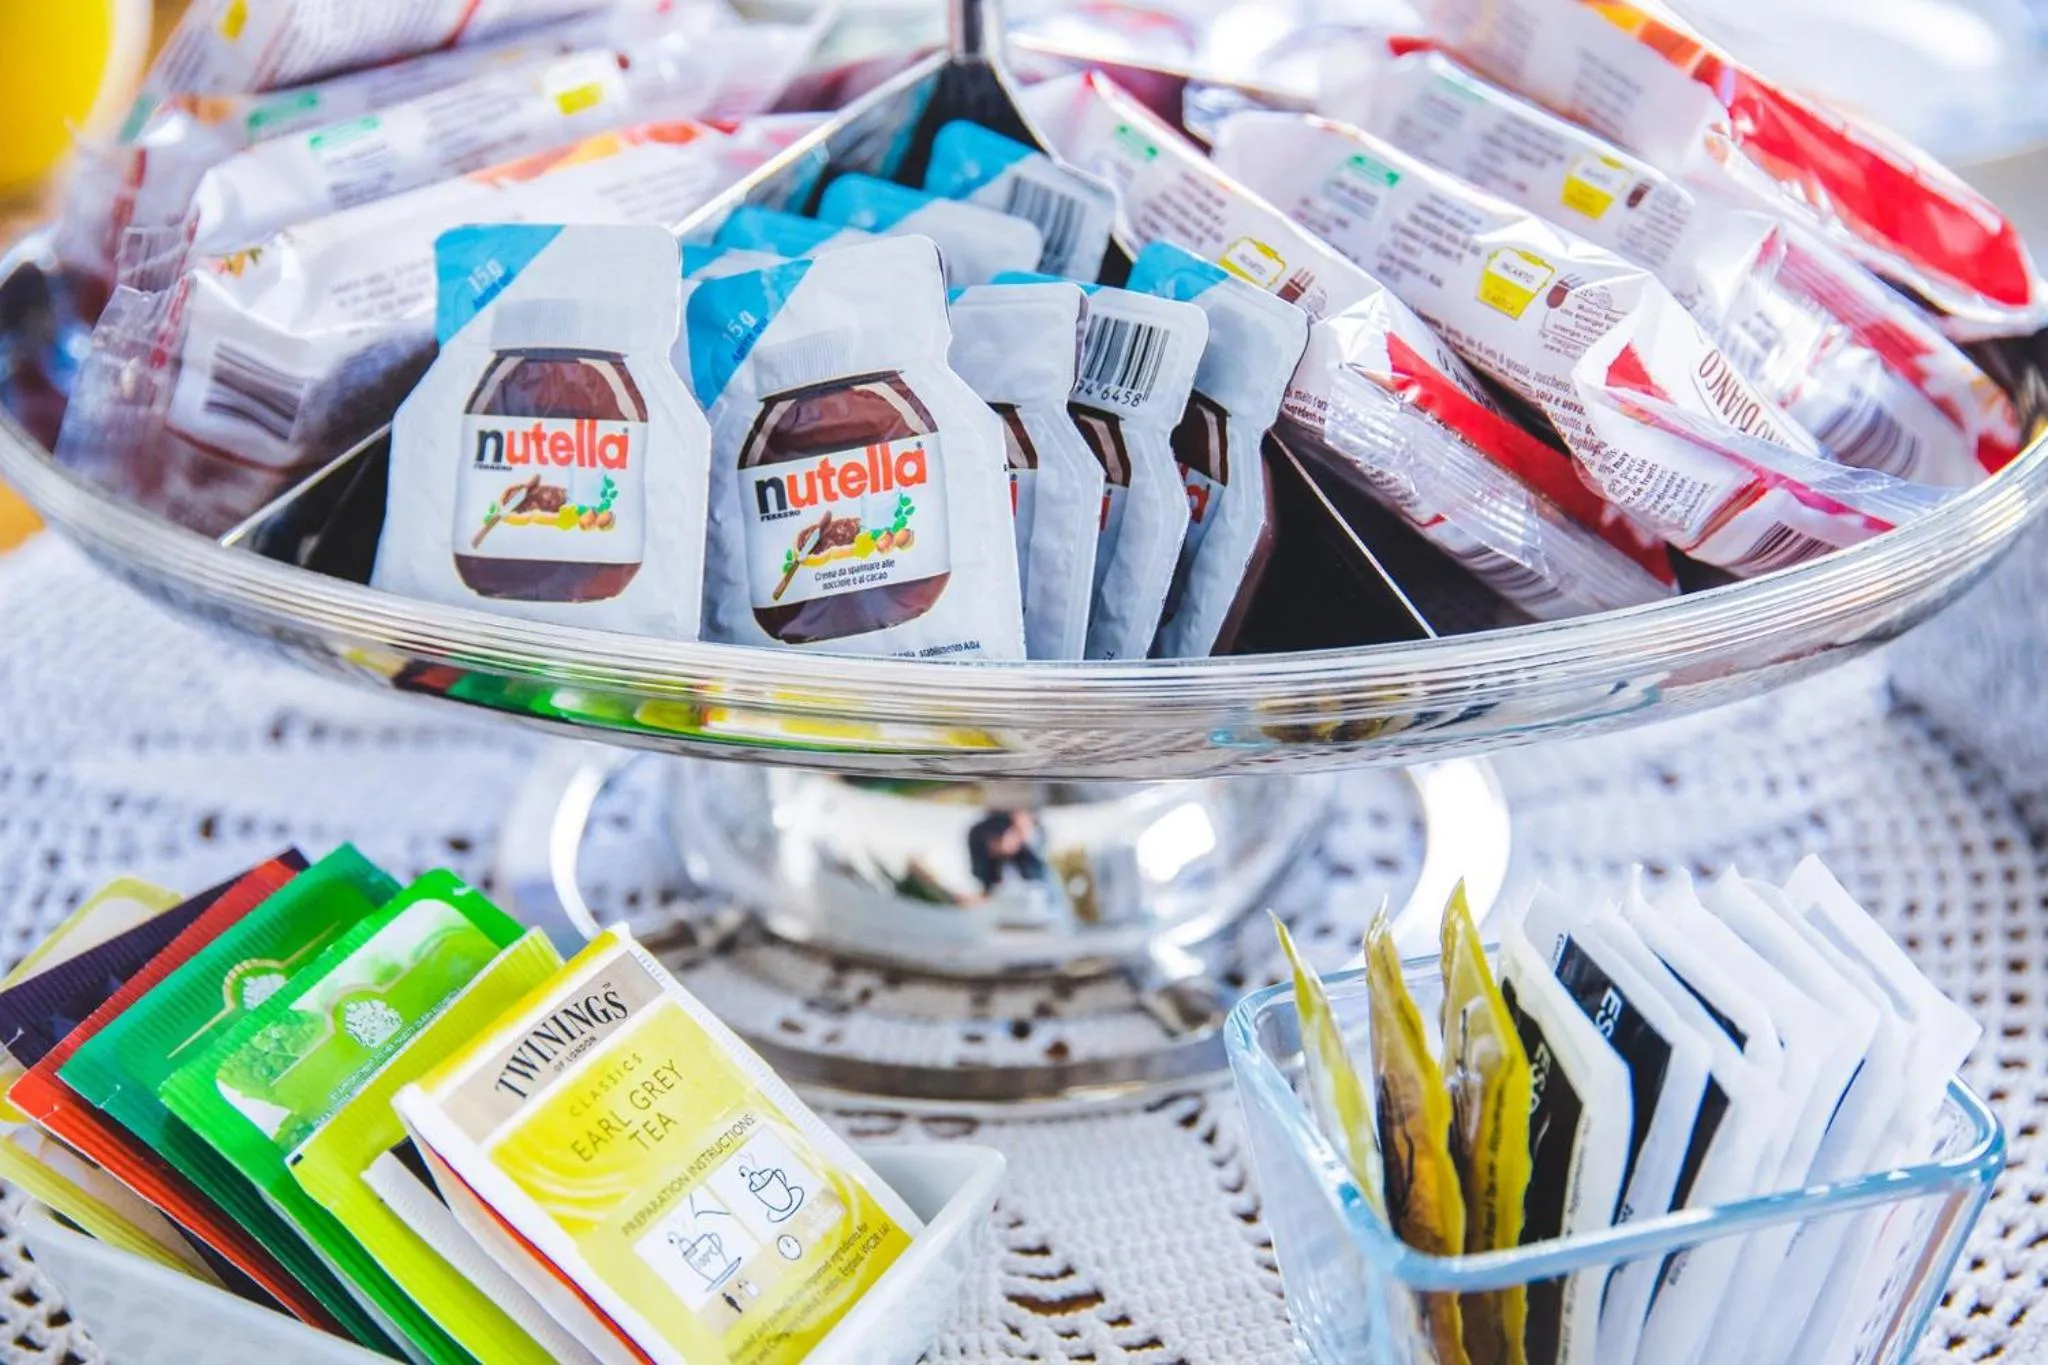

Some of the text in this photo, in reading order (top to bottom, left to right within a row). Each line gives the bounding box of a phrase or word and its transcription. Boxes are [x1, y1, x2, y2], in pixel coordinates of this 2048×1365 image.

[1100, 385, 1142, 407] 6458
[475, 417, 629, 469] nutella
[755, 440, 928, 514] nutella
[494, 991, 628, 1100] TWININGS
[569, 1053, 643, 1118] CLASSICS
[570, 1058, 684, 1163] EARL GREY
[628, 1112, 679, 1152] TEA
[621, 1173, 691, 1237] PREPARATION
